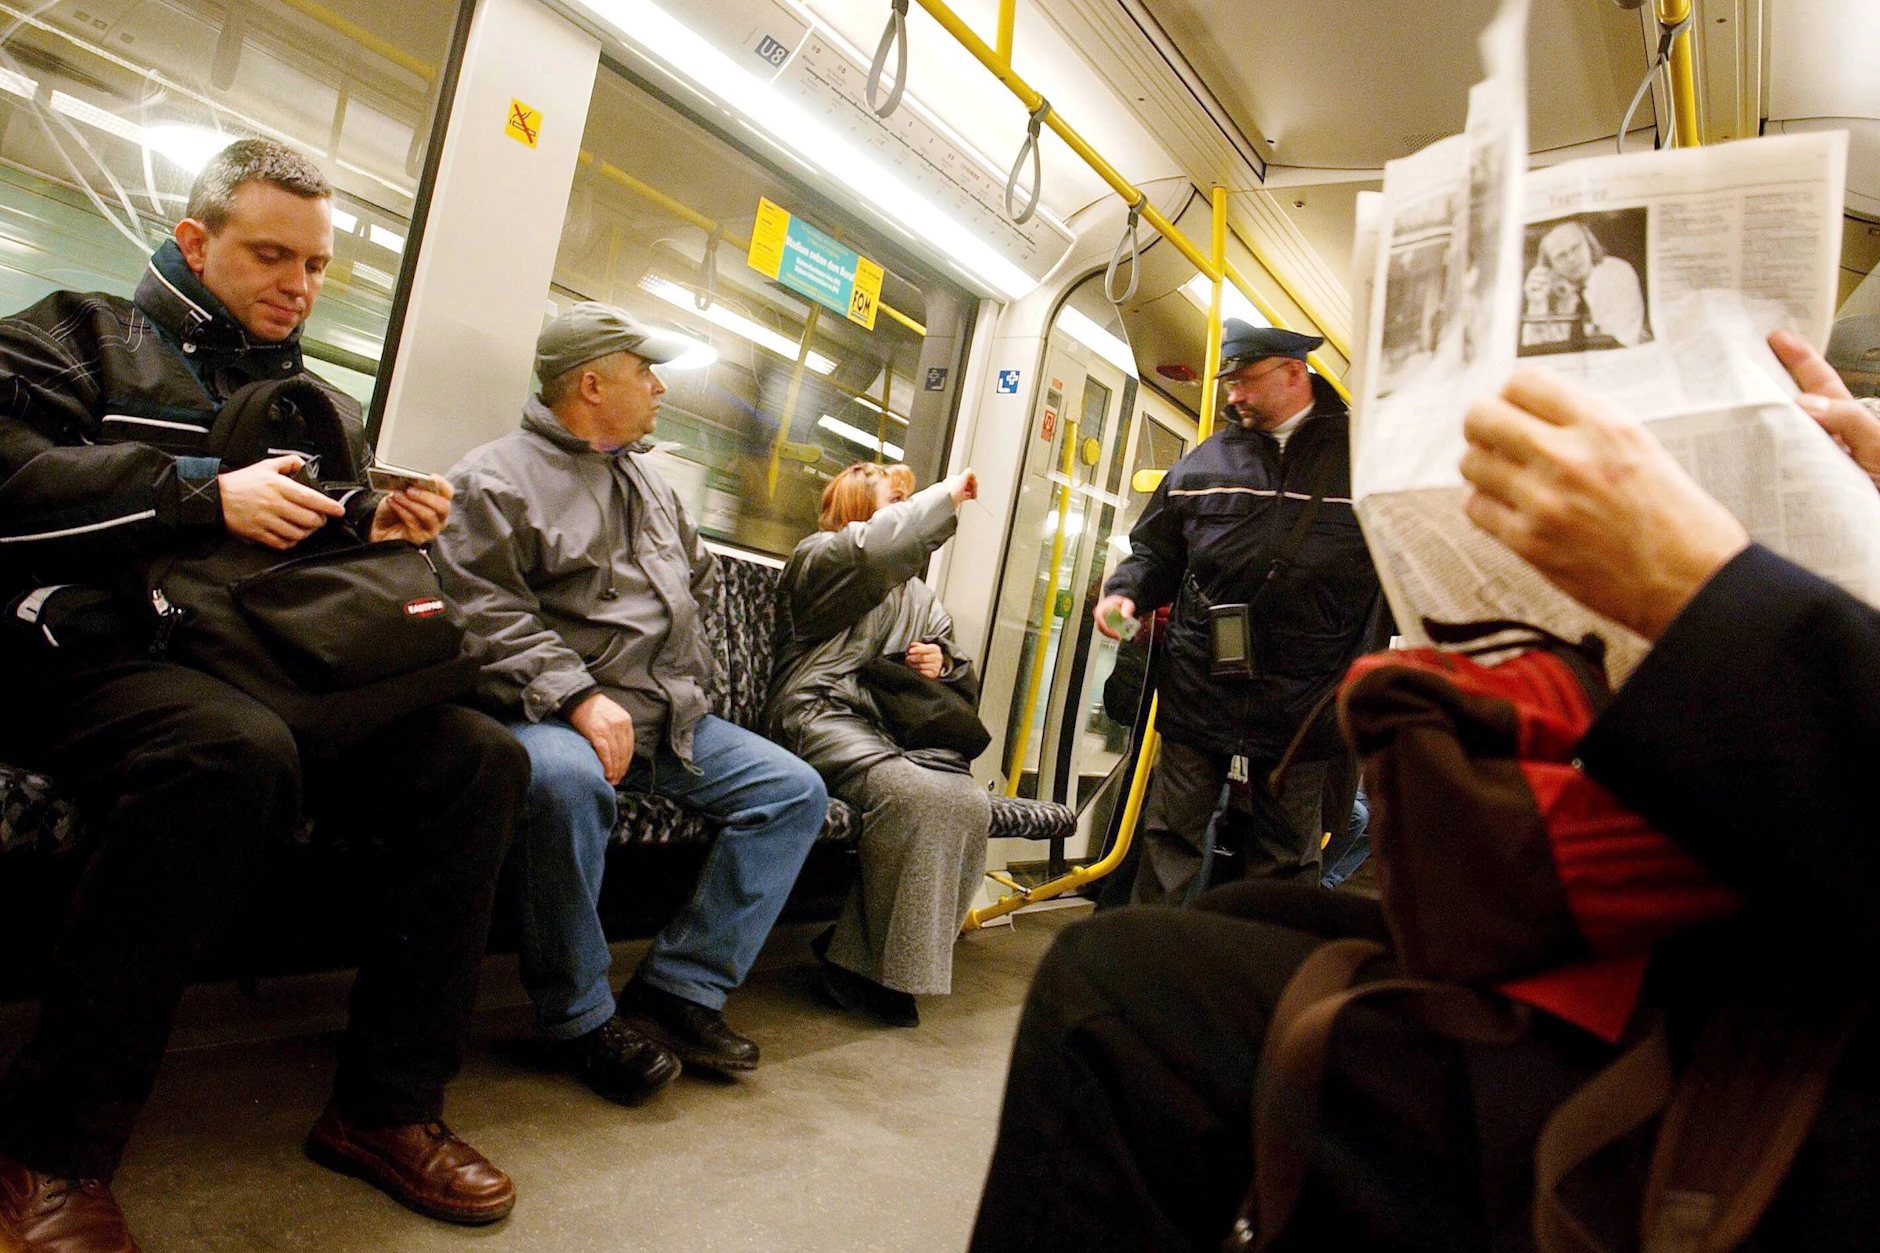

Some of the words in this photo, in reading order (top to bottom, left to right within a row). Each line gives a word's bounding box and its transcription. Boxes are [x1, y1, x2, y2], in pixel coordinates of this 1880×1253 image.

[760, 39, 786, 65] U8
[852, 290, 871, 315] FOM
[408, 601, 443, 614] EASTPAK
